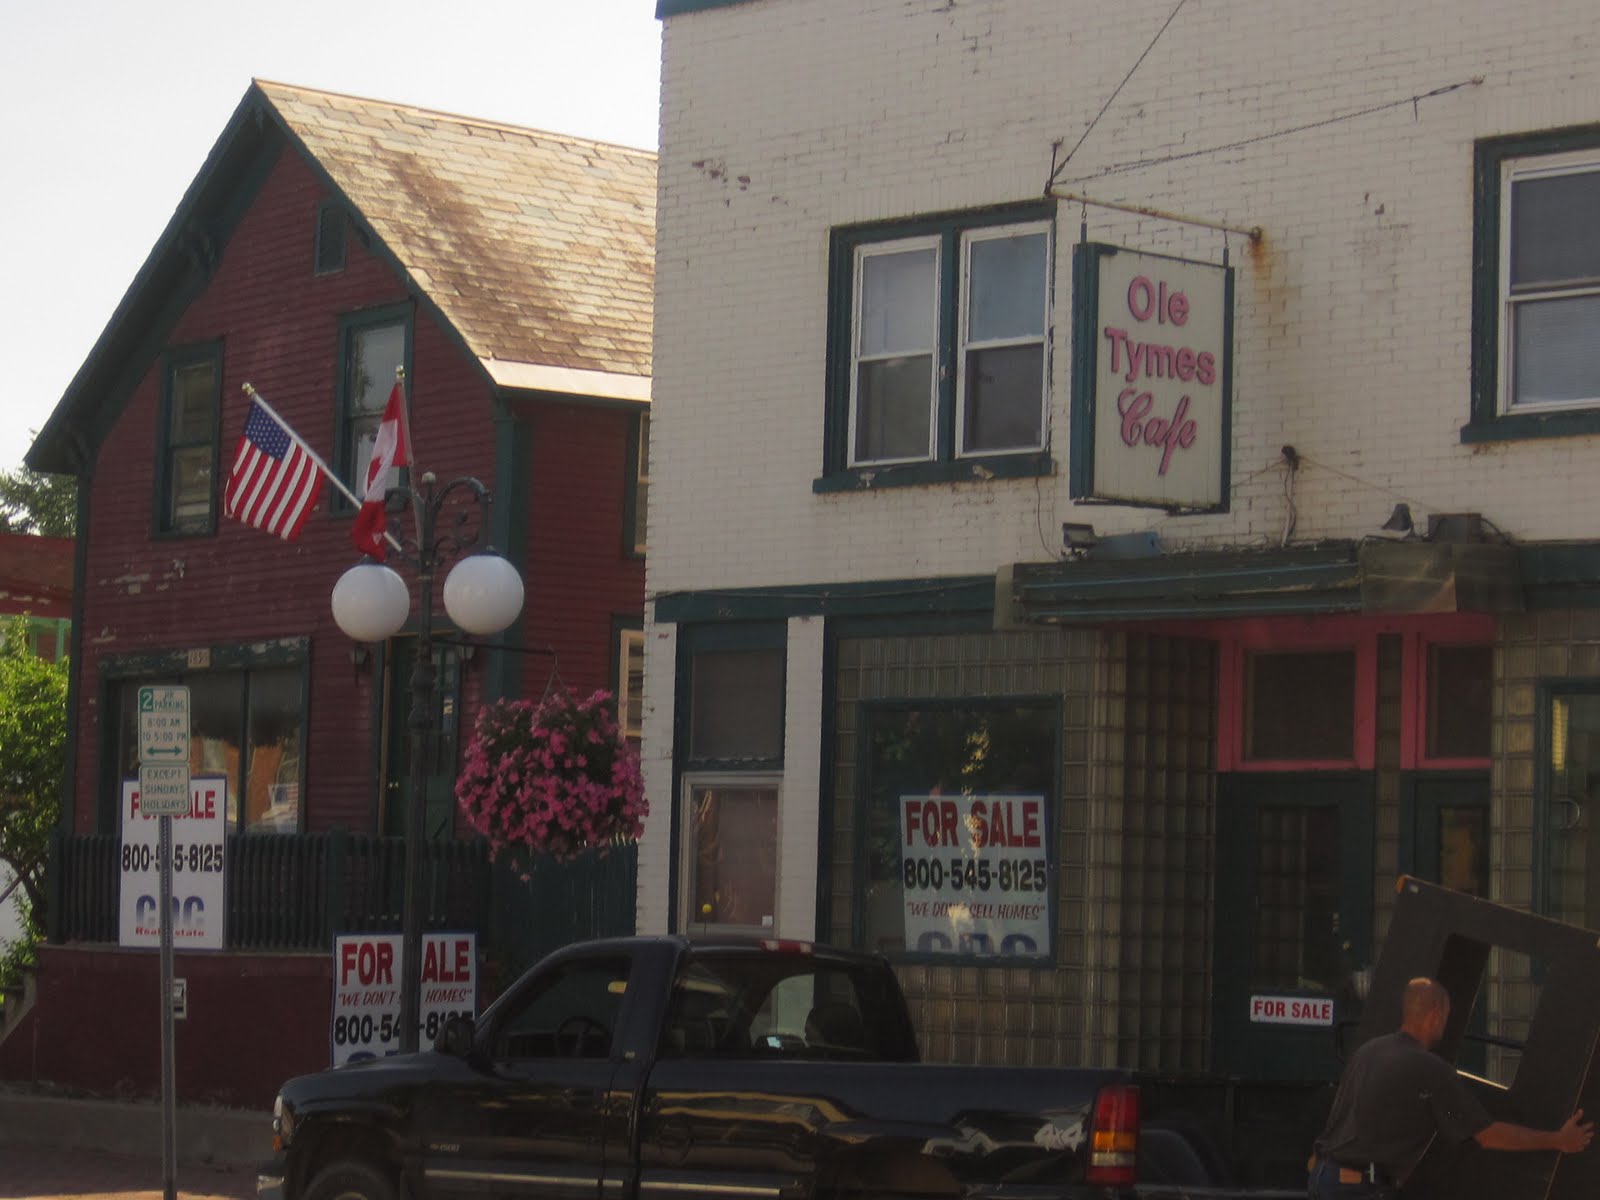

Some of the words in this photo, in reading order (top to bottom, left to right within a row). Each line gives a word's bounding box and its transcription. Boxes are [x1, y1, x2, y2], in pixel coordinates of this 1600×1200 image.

[1127, 275, 1190, 327] Ole
[1104, 326, 1216, 385] Tymes
[1117, 388, 1197, 476] Cafe
[142, 692, 153, 710] 2
[155, 701, 185, 710] PARKING
[170, 717, 181, 728] AM
[154, 732, 173, 743] 5:00
[176, 732, 187, 742] PM
[147, 769, 181, 780] EXCEPT
[145, 785, 185, 795] SUNDAYS
[905, 801, 959, 848] FOR
[970, 800, 1041, 849] SALE
[122, 844, 223, 873] 800-5-8125
[904, 857, 1048, 892] 800-545-8125
[970, 903, 995, 919] SELL
[341, 942, 394, 987] FOR
[421, 940, 470, 983] ALE
[1254, 1000, 1286, 1017] FOR
[1291, 1001, 1331, 1020] SALE
[334, 1010, 474, 1046] 800-5-8
